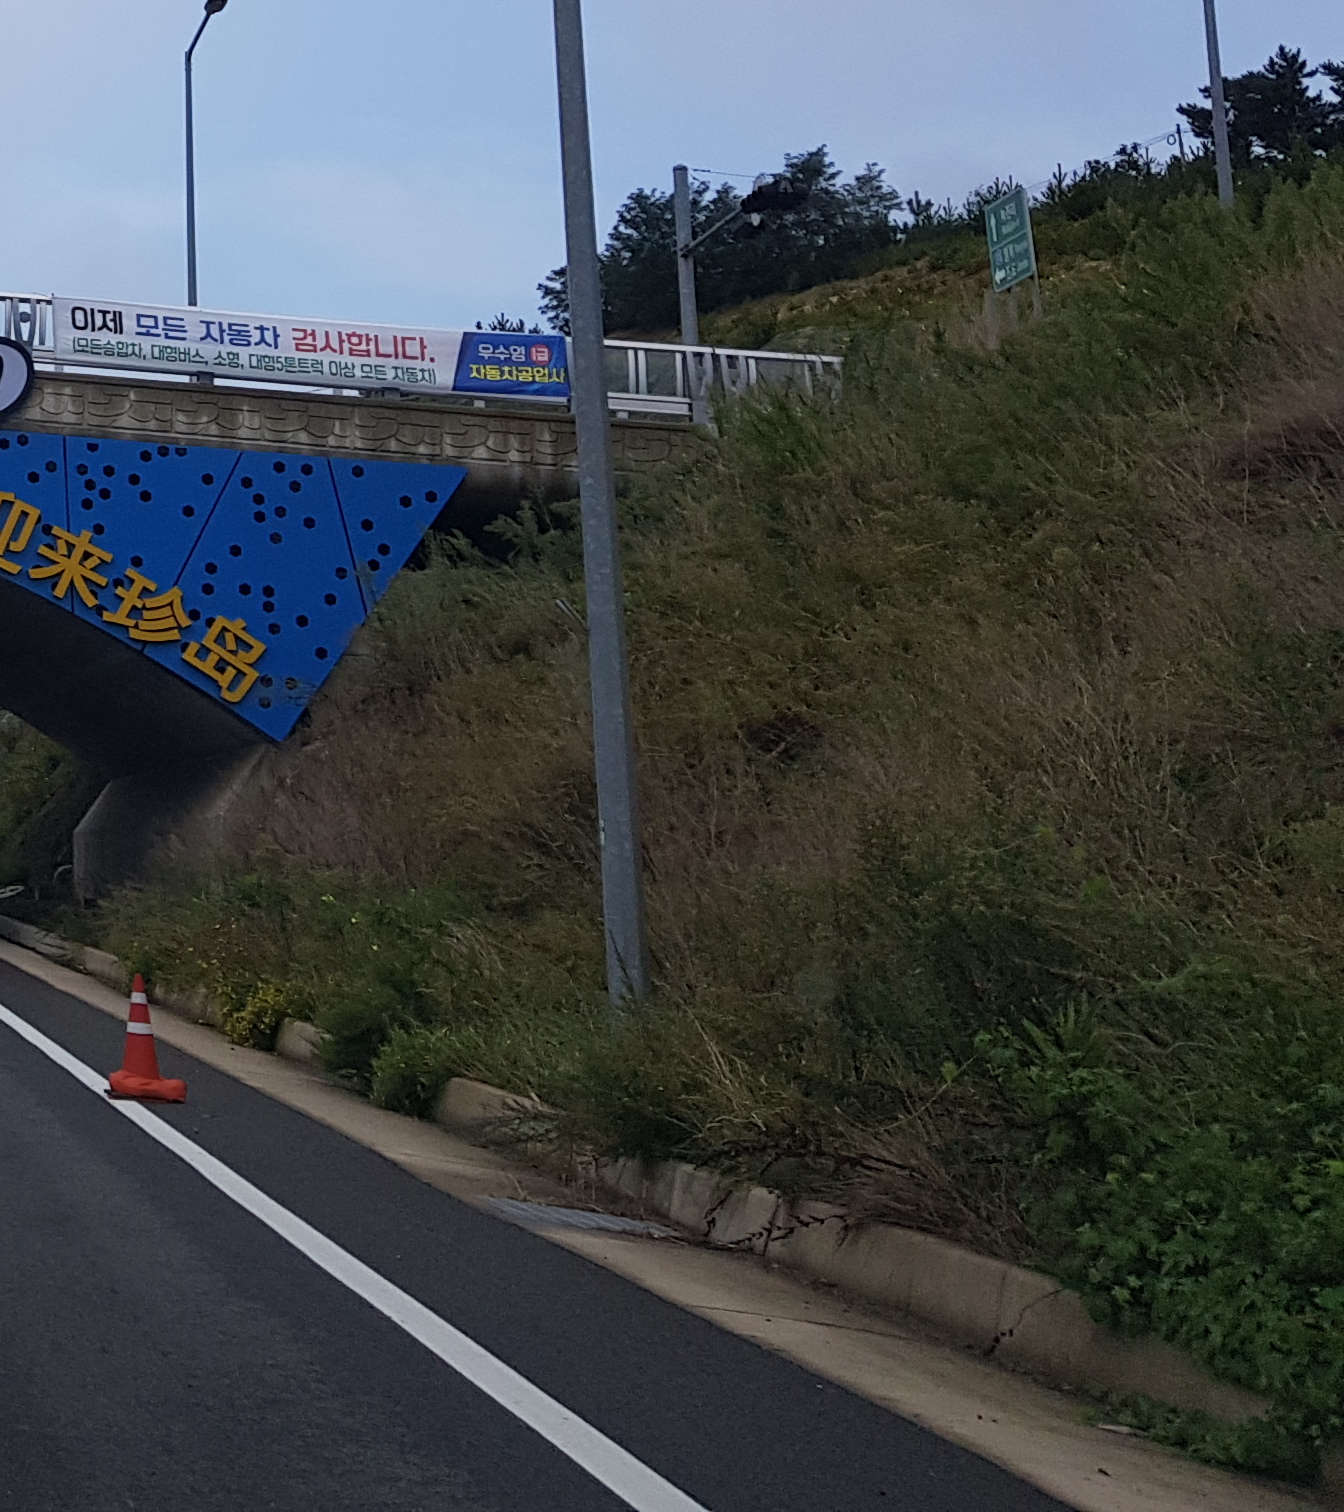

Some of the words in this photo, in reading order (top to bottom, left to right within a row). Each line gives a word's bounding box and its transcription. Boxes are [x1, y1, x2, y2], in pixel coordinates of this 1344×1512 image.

[71, 305, 123, 335] 이제
[135, 313, 188, 341] 모든
[199, 319, 281, 350] 자동차
[291, 327, 436, 364] 검사합니다.
[151, 344, 209, 366] 대형버스,
[213, 350, 244, 370] 소형,
[328, 359, 356, 378] 이상
[360, 363, 388, 381] 모든
[392, 365, 437, 385] 자동차)
[477, 342, 526, 362] 우수영
[469, 363, 566, 384] 자동차공업사
